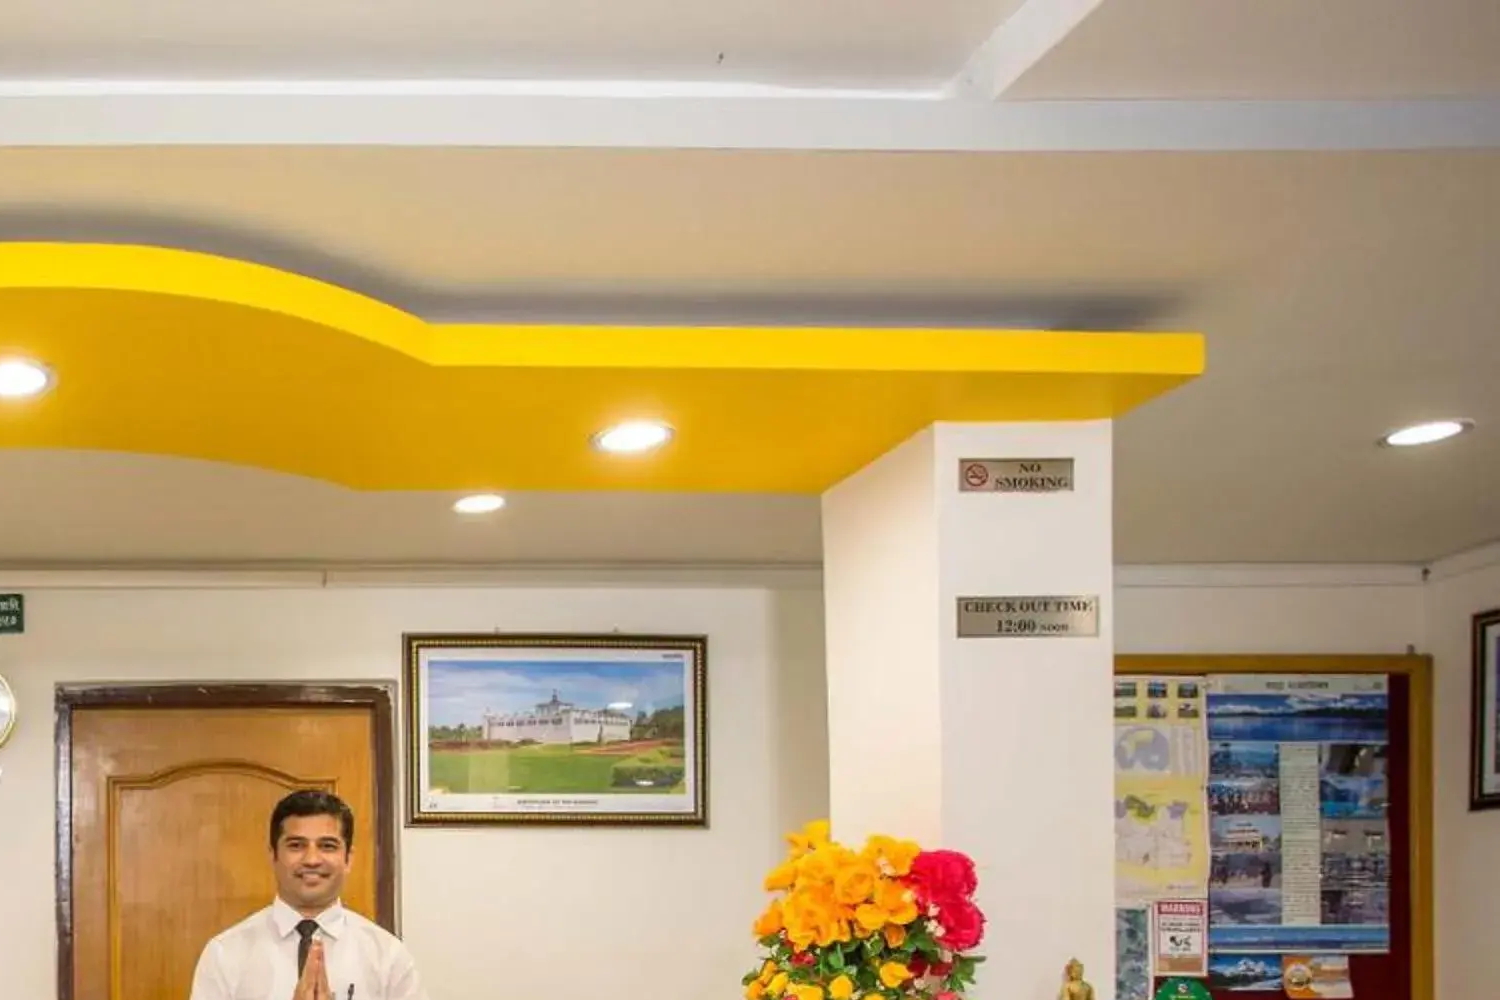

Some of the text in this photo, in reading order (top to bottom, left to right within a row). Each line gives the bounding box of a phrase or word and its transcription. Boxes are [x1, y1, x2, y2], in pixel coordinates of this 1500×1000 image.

[1019, 463, 1041, 474] NO
[995, 477, 1068, 489] SMOKING
[964, 600, 1093, 613] CHECK OUT TIME
[997, 619, 1036, 632] 12:00
